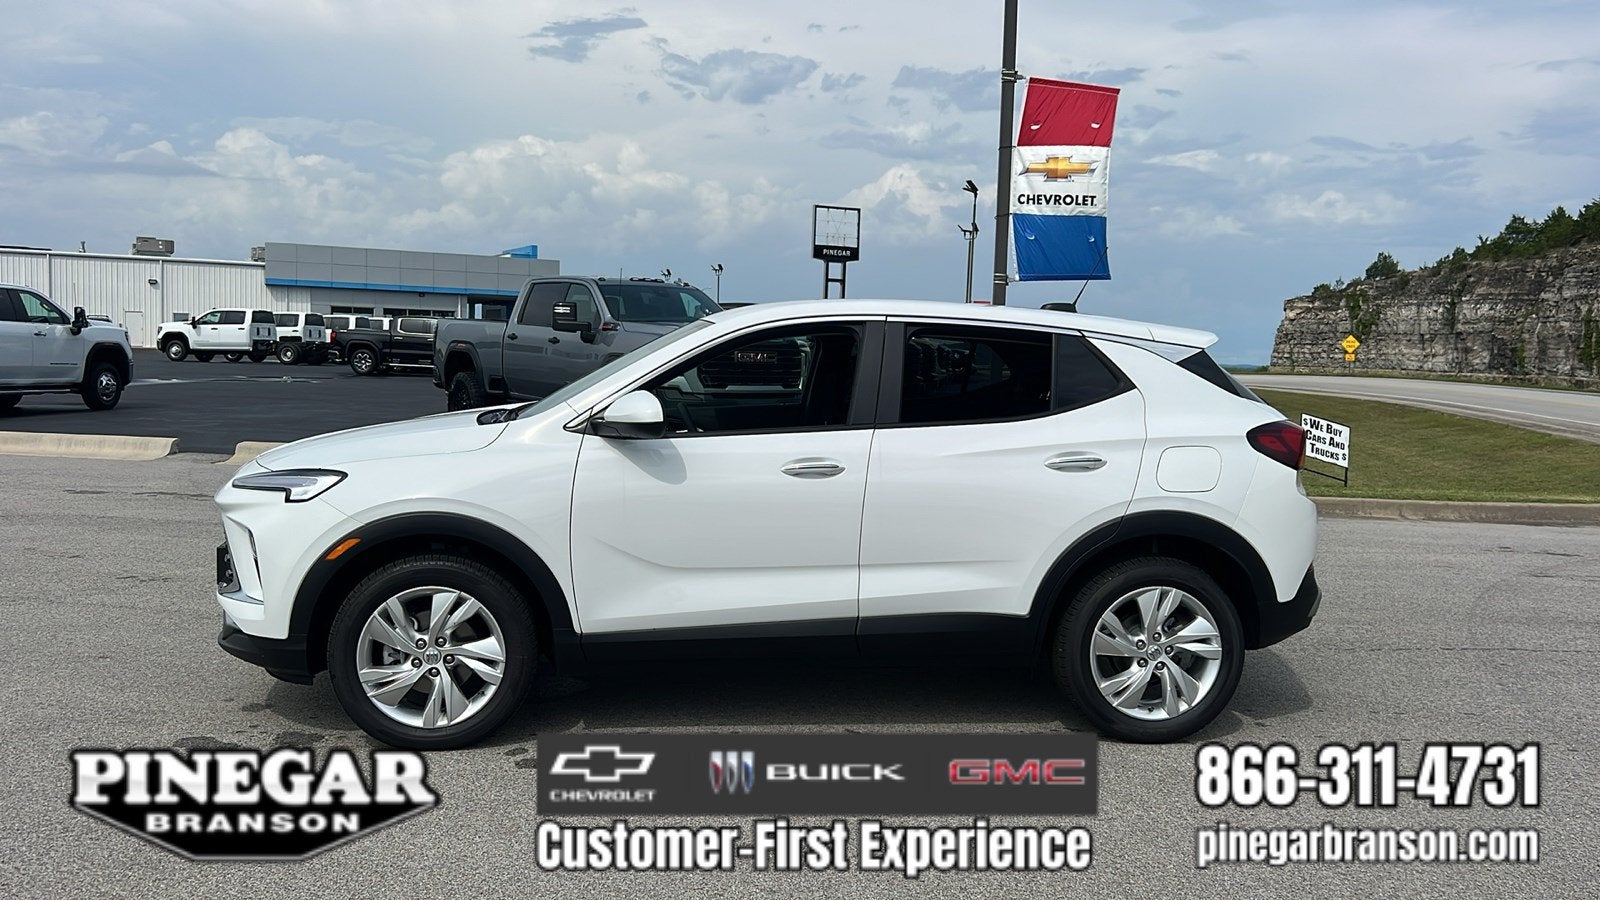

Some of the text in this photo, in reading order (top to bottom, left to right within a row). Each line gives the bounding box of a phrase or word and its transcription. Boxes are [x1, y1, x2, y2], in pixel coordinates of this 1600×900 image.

[1017, 193, 1097, 206] CHEVROLET
[823, 248, 851, 257] PINEGAR
[1326, 424, 1342, 437] BUY
[1306, 430, 1345, 450] CARS AND
[1310, 443, 1339, 460] TRUCKS
